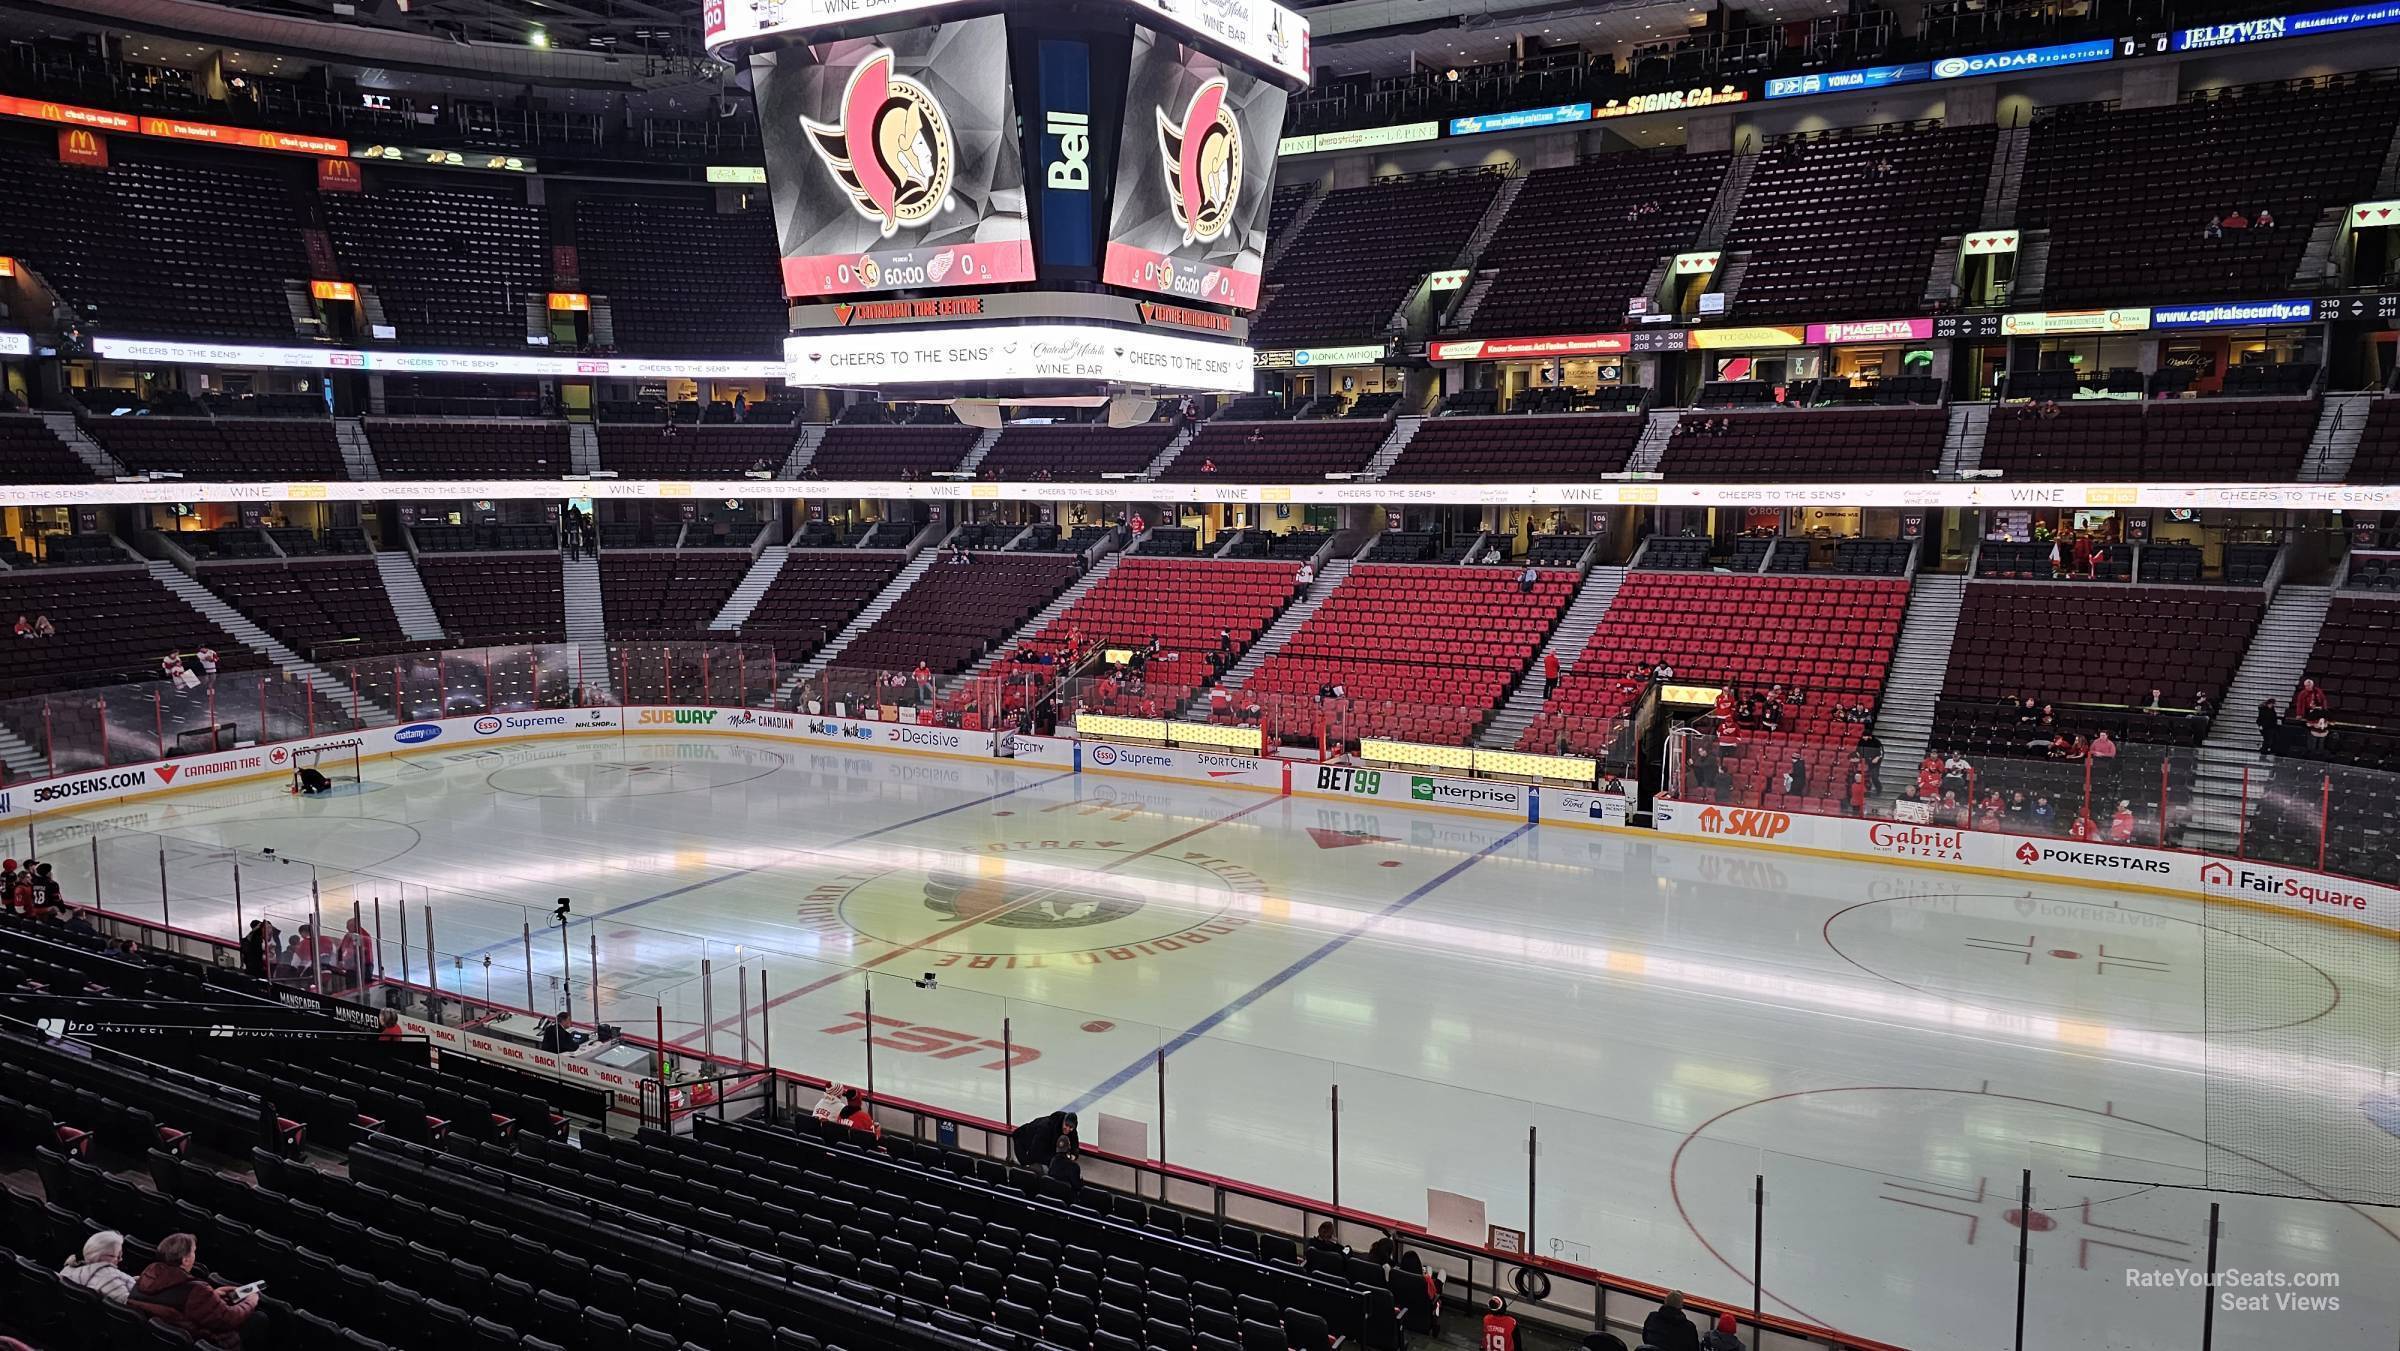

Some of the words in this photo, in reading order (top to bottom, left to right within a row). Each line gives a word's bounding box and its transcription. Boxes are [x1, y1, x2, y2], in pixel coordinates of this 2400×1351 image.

[824, 1, 860, 14] WINE
[2295, 16, 2349, 30] RELIABILITY
[2351, 14, 2366, 23] for
[2367, 11, 2386, 20] real
[1203, 13, 1225, 34] WINE
[1228, 25, 1247, 44] BAR
[2157, 38, 2168, 51] 0
[2191, 38, 2236, 49] WINDOWS
[2250, 31, 2284, 41] DOORS
[2124, 41, 2135, 55] 0
[1969, 53, 2038, 71] GADAR
[2040, 47, 2110, 62] PROMOTIONS
[1828, 73, 1864, 87] YOW.CA
[1627, 87, 1713, 114] SIGNS.CA
[1047, 111, 1090, 191] Bell
[961, 255, 974, 275] 0
[1145, 261, 1154, 281] 0
[838, 264, 850, 284] 0
[884, 266, 925, 285] 60:00
[1174, 275, 1200, 294] 60:00
[1221, 277, 1229, 296] 0
[2320, 300, 2340, 308] 310
[2379, 297, 2397, 305] 311
[856, 303, 913, 319] CANADIAN
[914, 301, 938, 317] TIRE
[940, 298, 982, 315] CENTRE
[2156, 303, 2310, 324] www.capitalsecurity.ca
[2319, 311, 2339, 319] 210
[2378, 308, 2396, 317] 211
[1938, 319, 1956, 327] 309
[1981, 317, 1997, 325] 310
[1842, 322, 1912, 335] MAGENTA
[1981, 327, 1997, 335] 210
[1634, 334, 1650, 342] 308
[1668, 332, 1684, 340] 309
[1737, 332, 1775, 342] CANADA
[1534, 342, 1546, 351] Act
[1668, 341, 1684, 349] 209
[128, 346, 168, 357] CHEERS
[172, 347, 184, 357] TO
[186, 348, 208, 358] THE
[830, 352, 885, 367] CHEERS
[890, 351, 911, 365] TO
[914, 350, 944, 364] THE
[397, 358, 432, 366] CHEERS
[451, 359, 470, 367] THE
[1129, 351, 1168, 368] CHEERS
[1172, 355, 1184, 369] TO
[1186, 357, 1203, 371] THE
[639, 364, 672, 372] CHEERS
[674, 364, 686, 372] TO
[688, 364, 703, 372] THE
[1036, 363, 1071, 375] WINE
[1076, 364, 1103, 375] BAR
[9, 491, 25, 499] TO
[29, 490, 49, 499] THE
[230, 486, 272, 498] WINE
[381, 487, 420, 495] CHEERS
[423, 487, 435, 495] TO
[436, 487, 455, 495] THE
[609, 485, 646, 495] WINE
[931, 486, 960, 496] WINE
[1216, 488, 1249, 500] WINE
[1337, 490, 1371, 498] CHEERS
[1374, 490, 1385, 498] TO
[1388, 490, 1405, 498] THE
[1561, 488, 1603, 501] WINE
[1718, 491, 1762, 500] CHEERS
[1766, 491, 1781, 500] TO
[1785, 491, 1807, 500] THE
[2011, 488, 2065, 502] WINE
[2220, 491, 2277, 502] CHEERS
[2282, 491, 2302, 501] TO
[2310, 491, 2336, 502] THE
[1593, 514, 1606, 522] 106
[2129, 520, 2147, 528] 108
[506, 715, 566, 730] Supreme
[638, 709, 718, 725] SUBWAY
[758, 716, 794, 729] CANADIAN
[902, 728, 959, 748] Decisive
[292, 745, 312, 757] AIR
[314, 737, 364, 756] CANADA
[1120, 750, 1174, 767] Supreme
[184, 761, 236, 778] CANADIAN
[239, 756, 261, 770] TIRE
[1317, 766, 1381, 795] BET99
[1417, 781, 1516, 803] enterprise
[1562, 798, 1584, 809] Ford
[1724, 809, 1790, 839] SKIP
[1869, 823, 1964, 850] Gabriel
[1897, 846, 1963, 861] PIZZA
[2043, 849, 2171, 874] POKERSTARS
[33, 891, 45, 904] 18
[2240, 872, 2367, 910] FairSquare
[279, 991, 321, 1011] MANSCAPED
[335, 1006, 380, 1029] MANSCAPED
[407, 1022, 427, 1034] BRICK
[436, 1030, 456, 1042] BRICK
[472, 1039, 493, 1052] BRICK
[503, 1047, 524, 1060] BRICK
[534, 1055, 556, 1068] BRICK
[567, 1063, 589, 1076] BRICK
[600, 1071, 622, 1085] BRICK
[1486, 1333, 1505, 1351] 19
